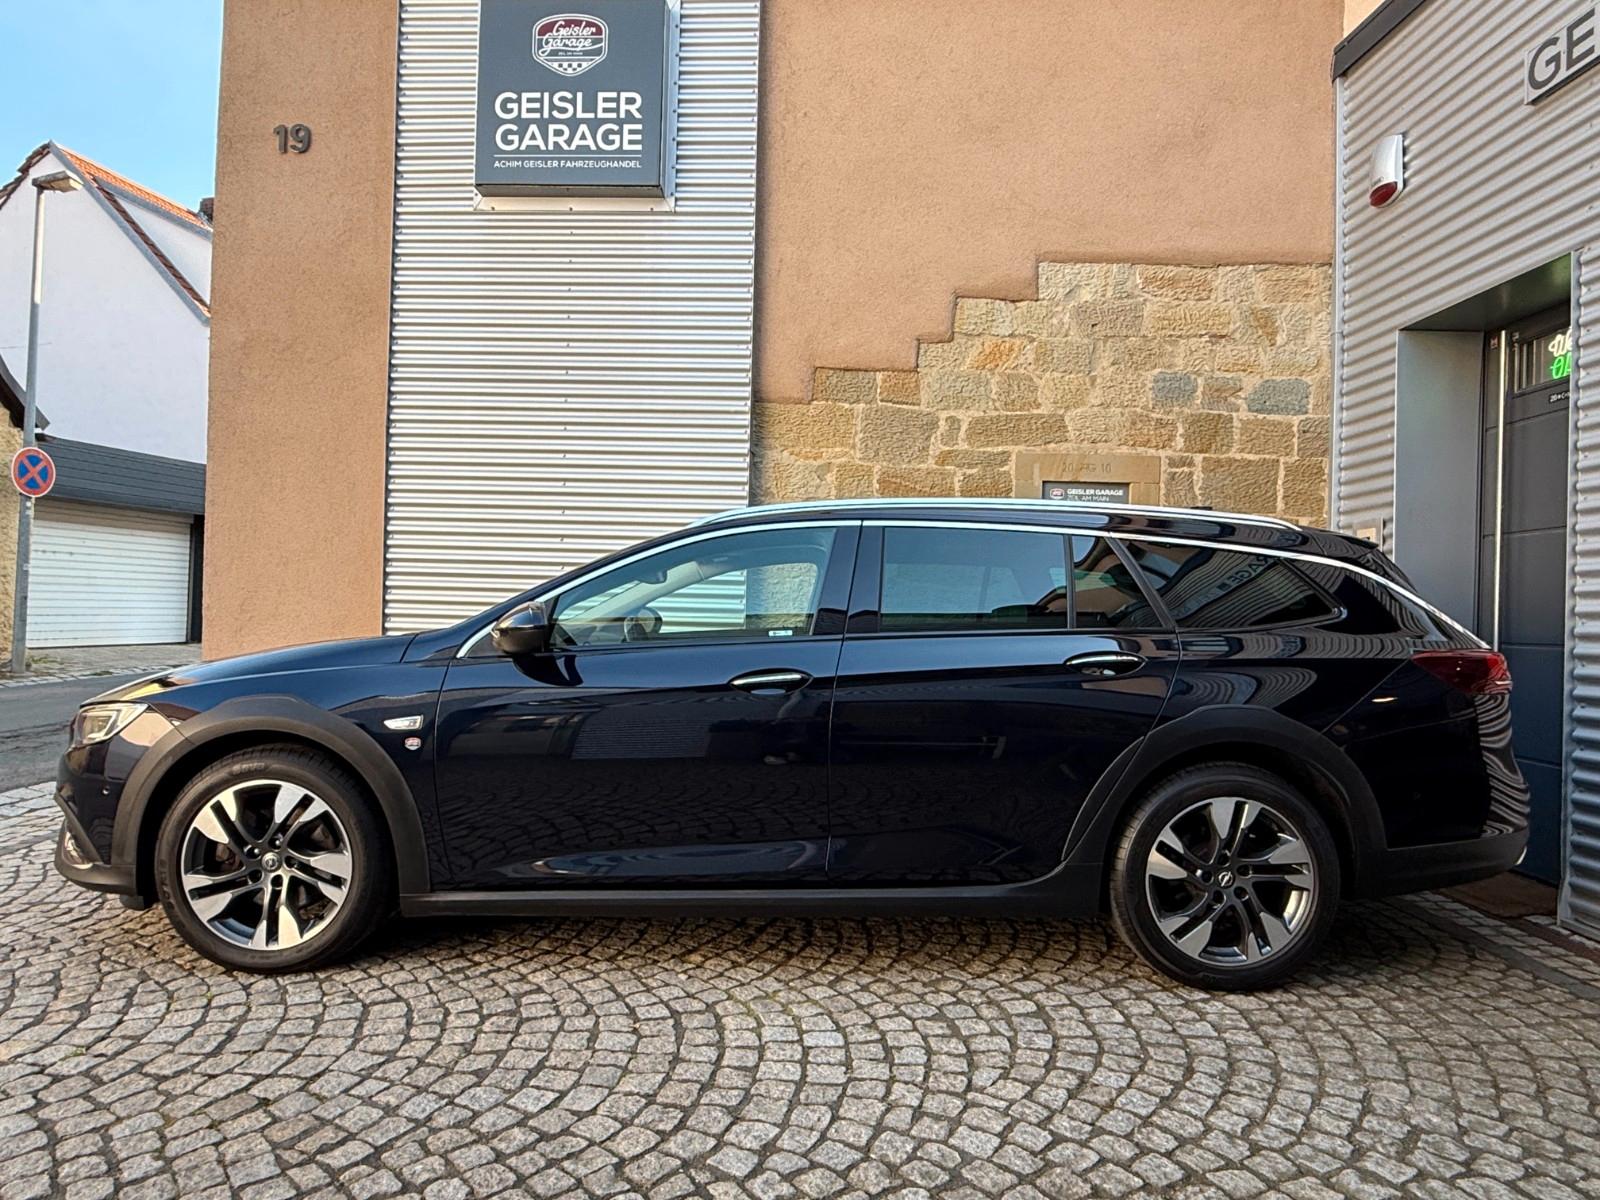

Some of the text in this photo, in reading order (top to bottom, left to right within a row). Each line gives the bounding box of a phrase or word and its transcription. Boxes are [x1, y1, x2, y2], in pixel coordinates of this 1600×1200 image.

[552, 20, 596, 38] Geisler
[540, 32, 593, 55] Garage
[1528, 7, 1596, 90] GE
[494, 91, 643, 120] GEISLER
[273, 123, 312, 154] 19
[495, 123, 643, 151] GARAGE
[494, 160, 642, 169] ACHIM GEISLER FAHRZEUGHANDEL
